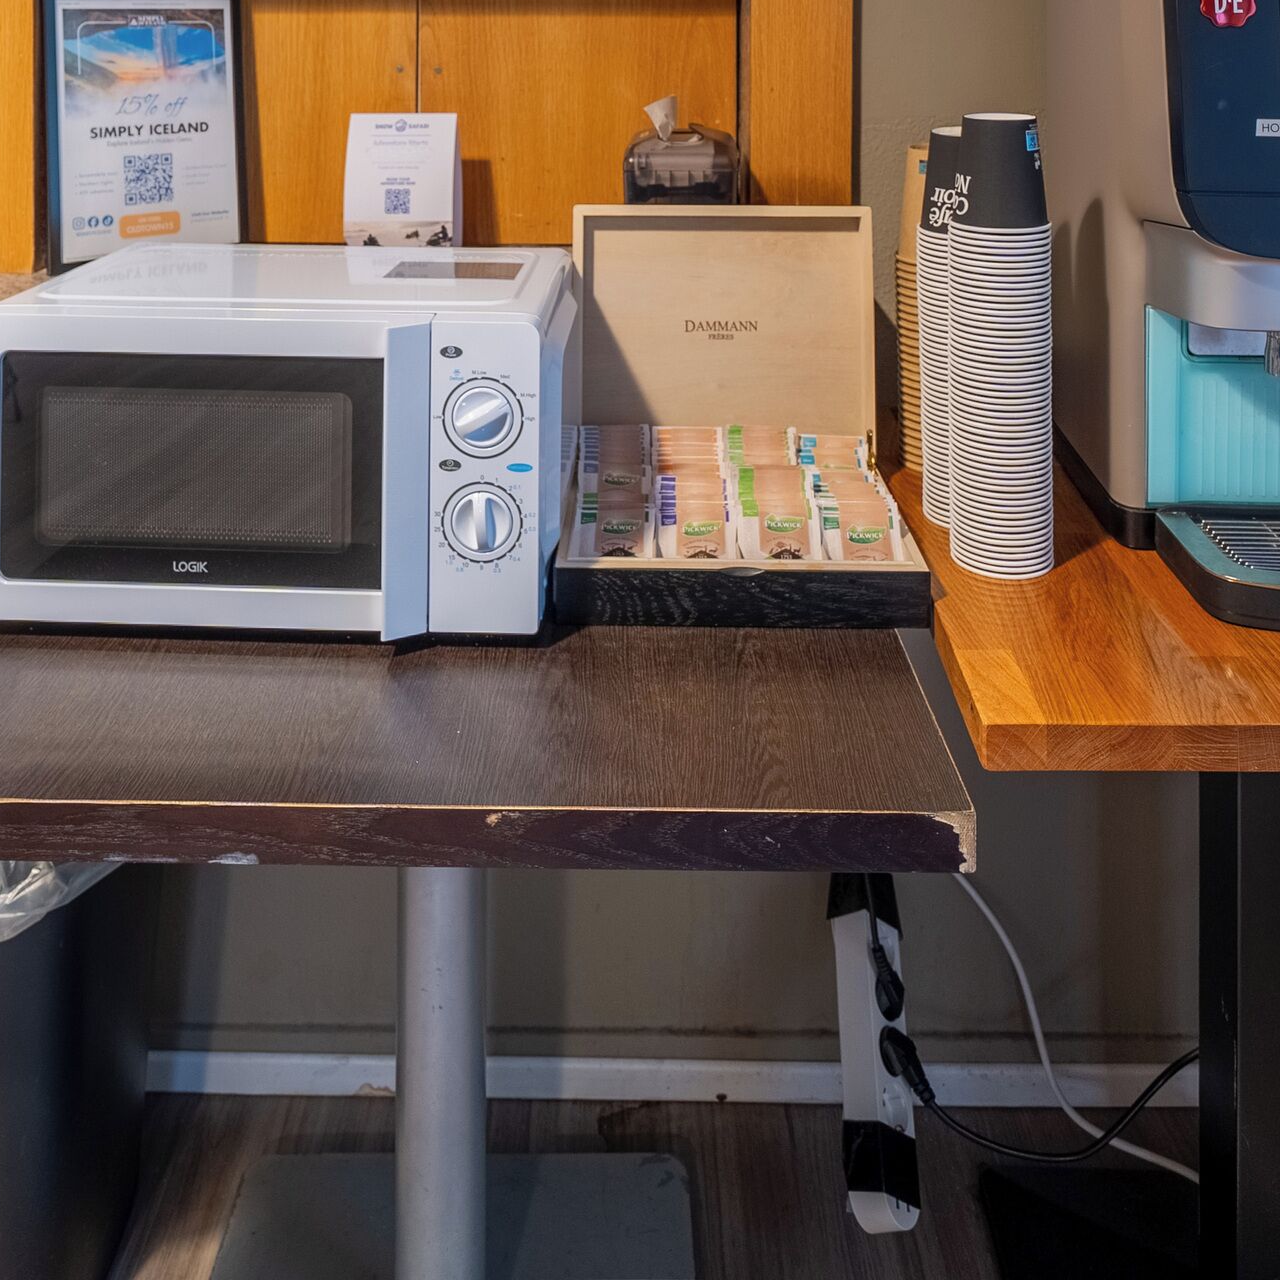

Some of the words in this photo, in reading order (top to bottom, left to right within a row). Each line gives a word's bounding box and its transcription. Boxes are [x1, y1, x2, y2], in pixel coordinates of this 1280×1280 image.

[115, 93, 159, 116] 15%
[164, 96, 188, 117] off
[90, 124, 144, 139] SIMPLY
[149, 122, 209, 135] ICELAND
[684, 319, 758, 333] DAMMANN
[682, 523, 721, 534] PICKWICK
[764, 519, 801, 529] PICKWICK
[846, 530, 883, 540] PICKWICK
[173, 561, 208, 573] LOGIK
